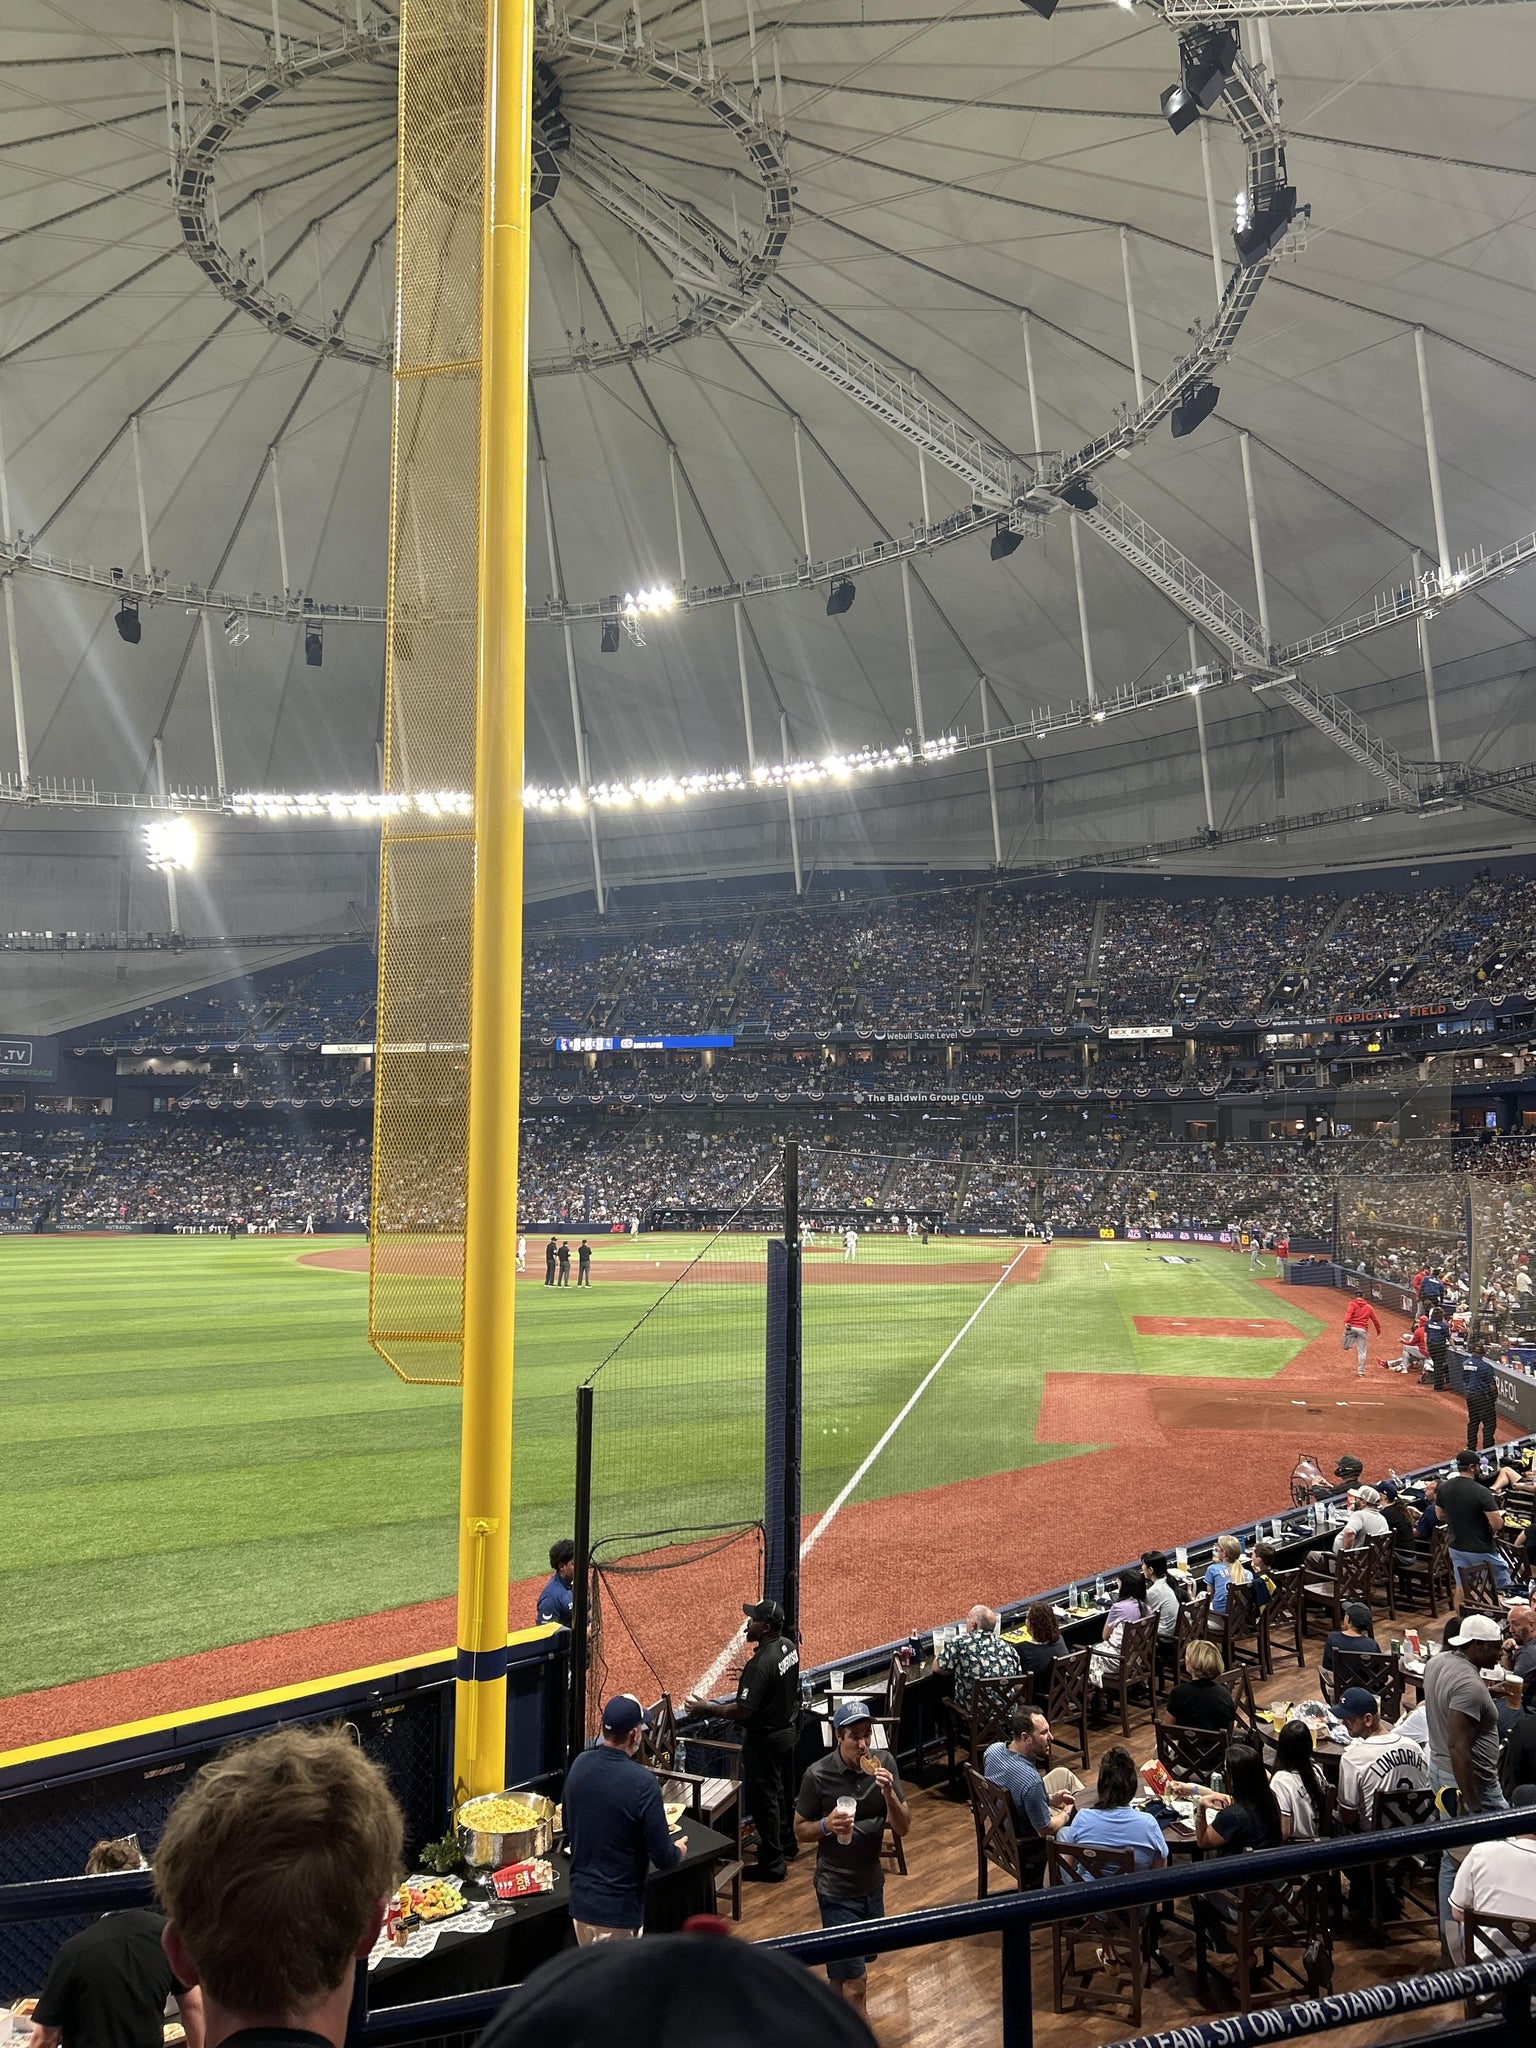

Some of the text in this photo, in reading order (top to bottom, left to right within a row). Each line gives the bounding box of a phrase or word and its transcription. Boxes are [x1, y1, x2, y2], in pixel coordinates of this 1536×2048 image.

[1409, 1005, 1447, 1018] FIELD
[887, 1031, 958, 1040] Webull Suite Level
[11, 1069, 53, 1077] MORTGAGE
[867, 1093, 984, 1103] The Baldwin Group Club
[610, 1224, 625, 1233] ACE
[1494, 1376, 1519, 1404] RAFOL
[1370, 1748, 1423, 1779] LONGORIA
[1210, 2016, 1246, 2046] SIT
[1247, 2008, 1292, 2038] ON,
[1292, 2002, 1327, 2028] OR
[1323, 1985, 1397, 2022] STAND
[1396, 1965, 1484, 2006] AGAINST
